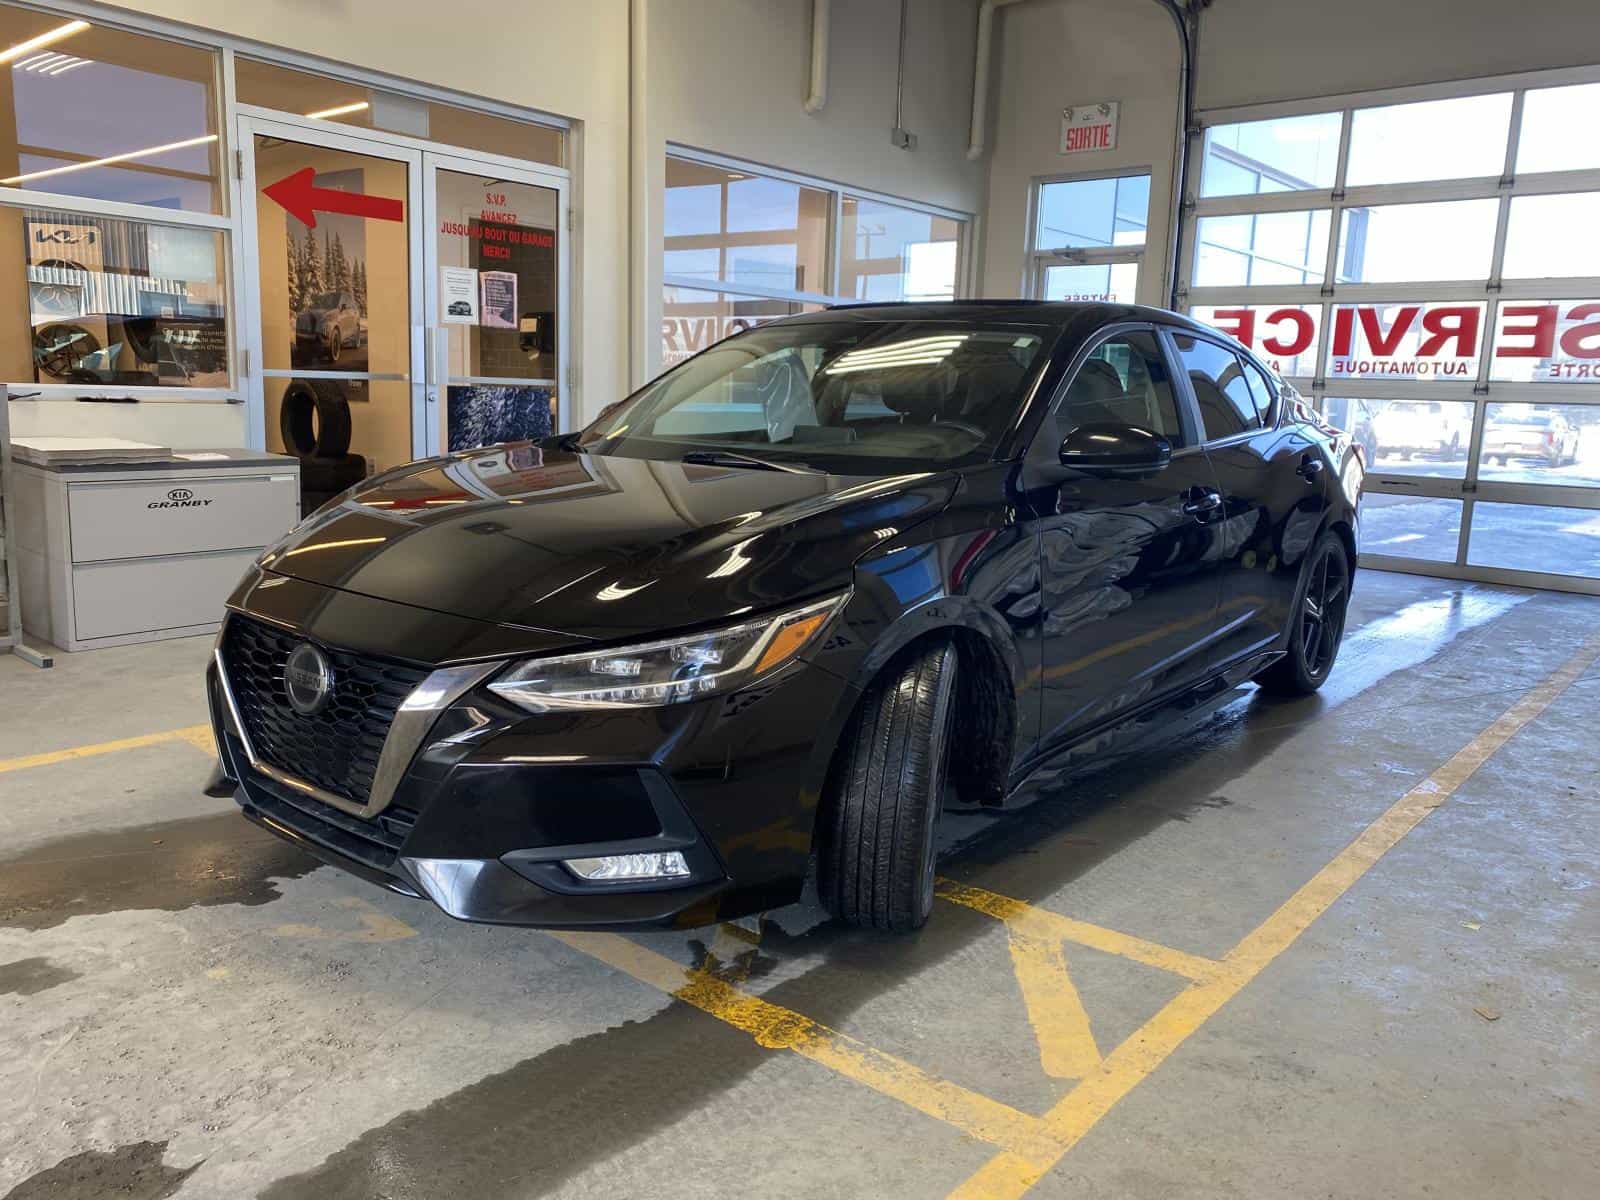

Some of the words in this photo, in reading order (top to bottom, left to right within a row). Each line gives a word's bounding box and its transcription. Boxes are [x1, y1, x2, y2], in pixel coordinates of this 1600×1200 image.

[1066, 124, 1111, 151] SORTIE
[522, 232, 553, 248] GARAGE
[147, 499, 213, 509] GRANBY
